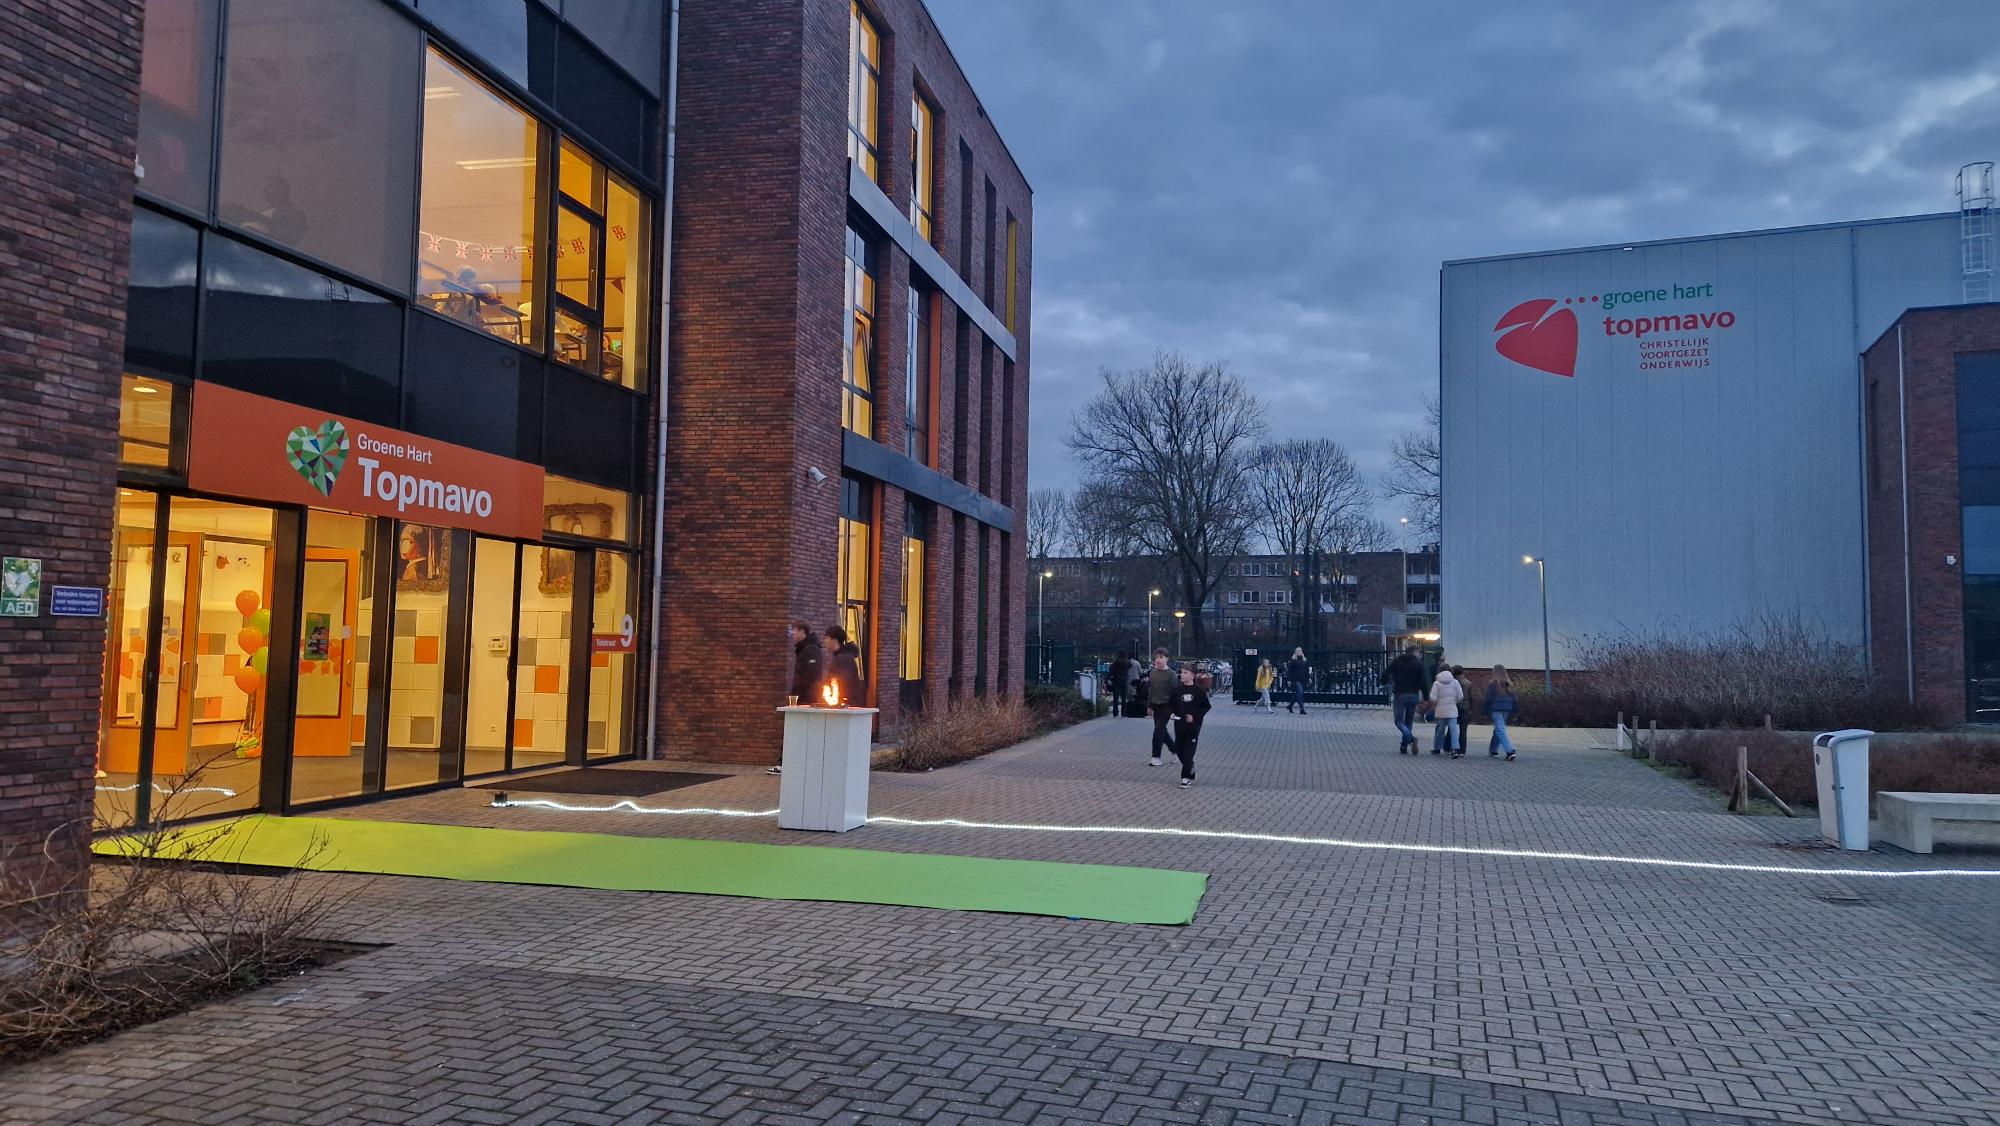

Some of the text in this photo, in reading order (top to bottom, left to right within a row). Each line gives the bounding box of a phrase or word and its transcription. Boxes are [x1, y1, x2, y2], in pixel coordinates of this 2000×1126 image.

[1602, 282, 1713, 310] groene hart
[1603, 311, 1736, 338] topmavo
[1640, 338, 1709, 350] CHRISTELIJK
[1640, 348, 1709, 360] VOORTGEZET
[1640, 358, 1710, 370] ONDERWIJS
[357, 433, 433, 465] Groene Hart
[357, 456, 493, 518] Topmavo
[5, 601, 34, 614] AED
[620, 614, 634, 648] 9
